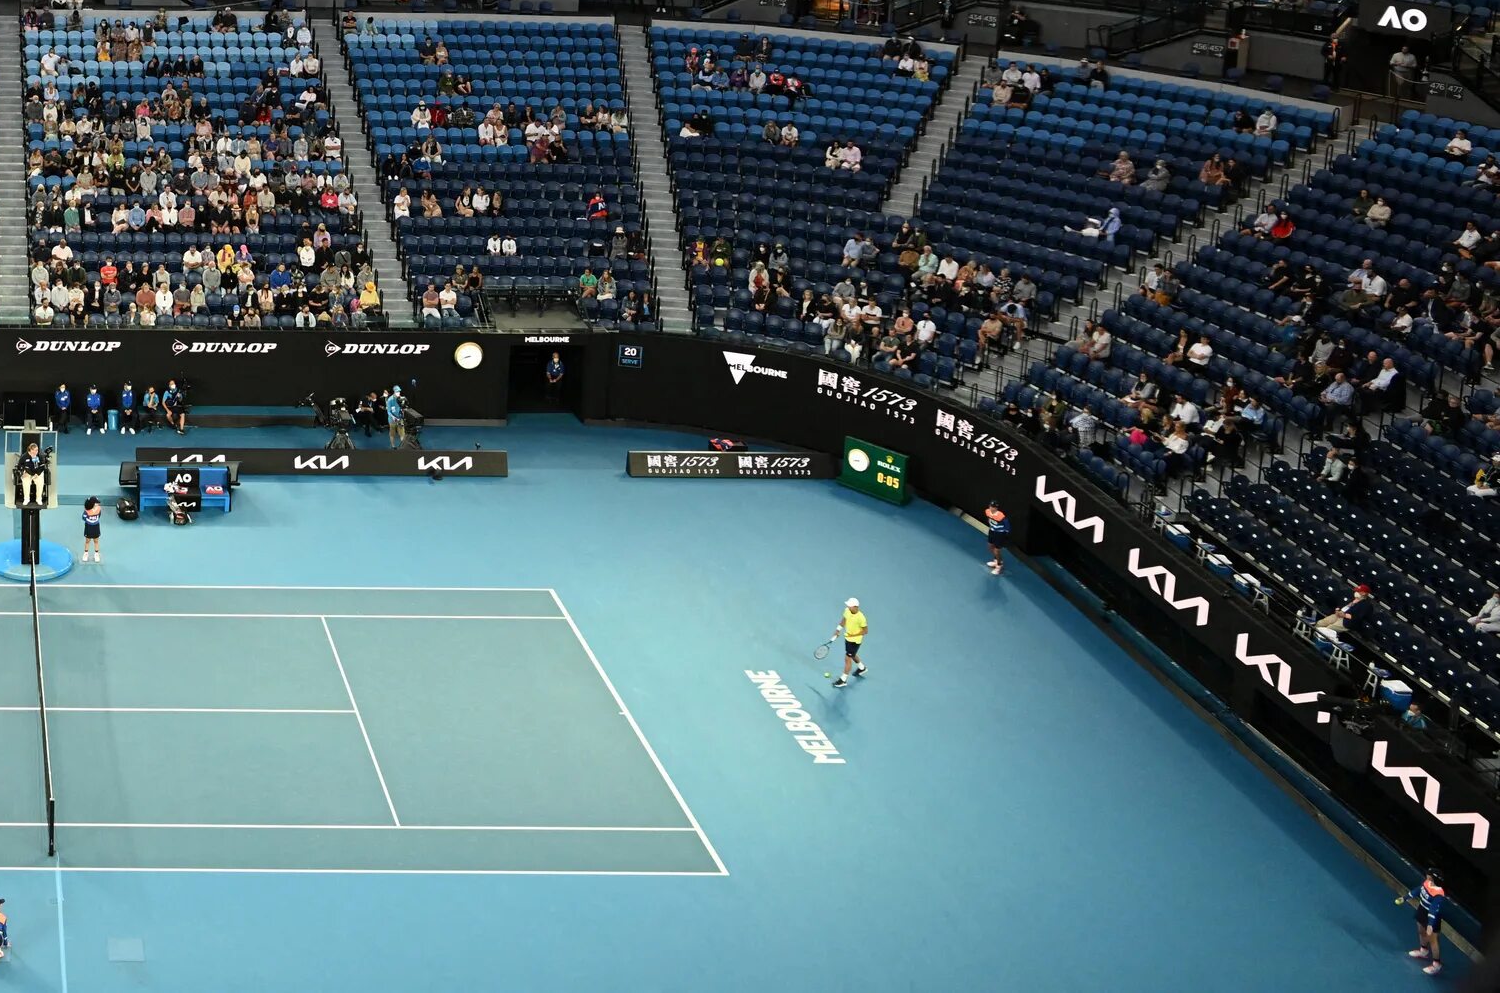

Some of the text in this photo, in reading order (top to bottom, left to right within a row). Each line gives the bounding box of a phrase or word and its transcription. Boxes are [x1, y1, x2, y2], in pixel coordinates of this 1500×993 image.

[983, 16, 997, 24] 435
[1378, 6, 1427, 31] AO
[1430, 82, 1445, 91] 476
[1447, 86, 1463, 95] 477
[32, 341, 122, 352] DUNLOP
[189, 343, 277, 352] DUNLOP
[342, 344, 429, 354] DUNLOP
[625, 347, 637, 356] 20
[729, 363, 787, 379] MELBOURNE
[817, 387, 915, 424] GUOJIAO 1573
[935, 428, 1017, 475] GUOJIAO 1573
[295, 456, 349, 469] KIA
[418, 456, 472, 470] KIA
[877, 460, 901, 472] ROLEX
[175, 473, 192, 482] AO
[877, 472, 899, 488] 0:05
[1036, 476, 1104, 543] KIA
[1129, 548, 1213, 625] KIA
[744, 670, 846, 763] MELBOURNE
[1372, 741, 1489, 848] KIA
